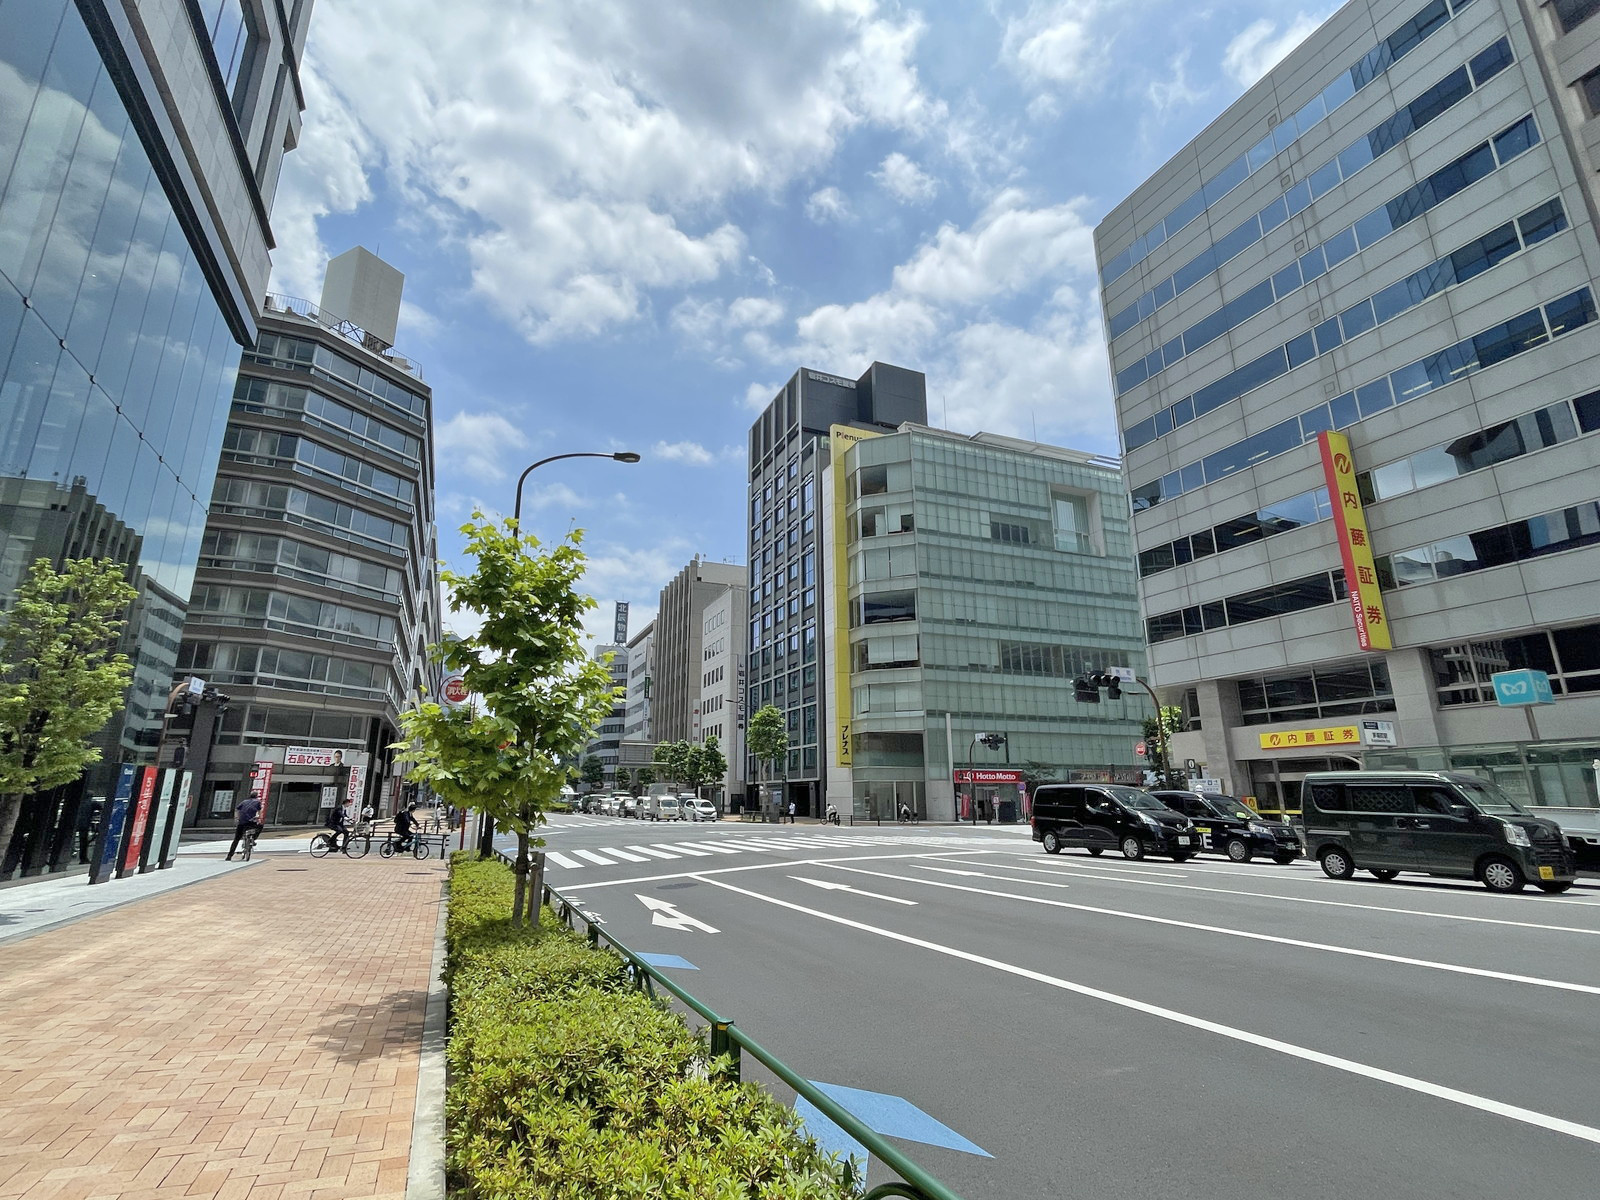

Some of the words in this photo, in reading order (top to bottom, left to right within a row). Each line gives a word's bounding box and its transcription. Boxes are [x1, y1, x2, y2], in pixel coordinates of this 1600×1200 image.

[1343, 490, 1382, 625] 内藤証券
[1351, 590, 1362, 612] NAITO
[1355, 612, 1368, 647] Securities
[1287, 729, 1354, 744] 内藤証券
[975, 772, 996, 780] Hotto
[996, 772, 1016, 780] Motto
